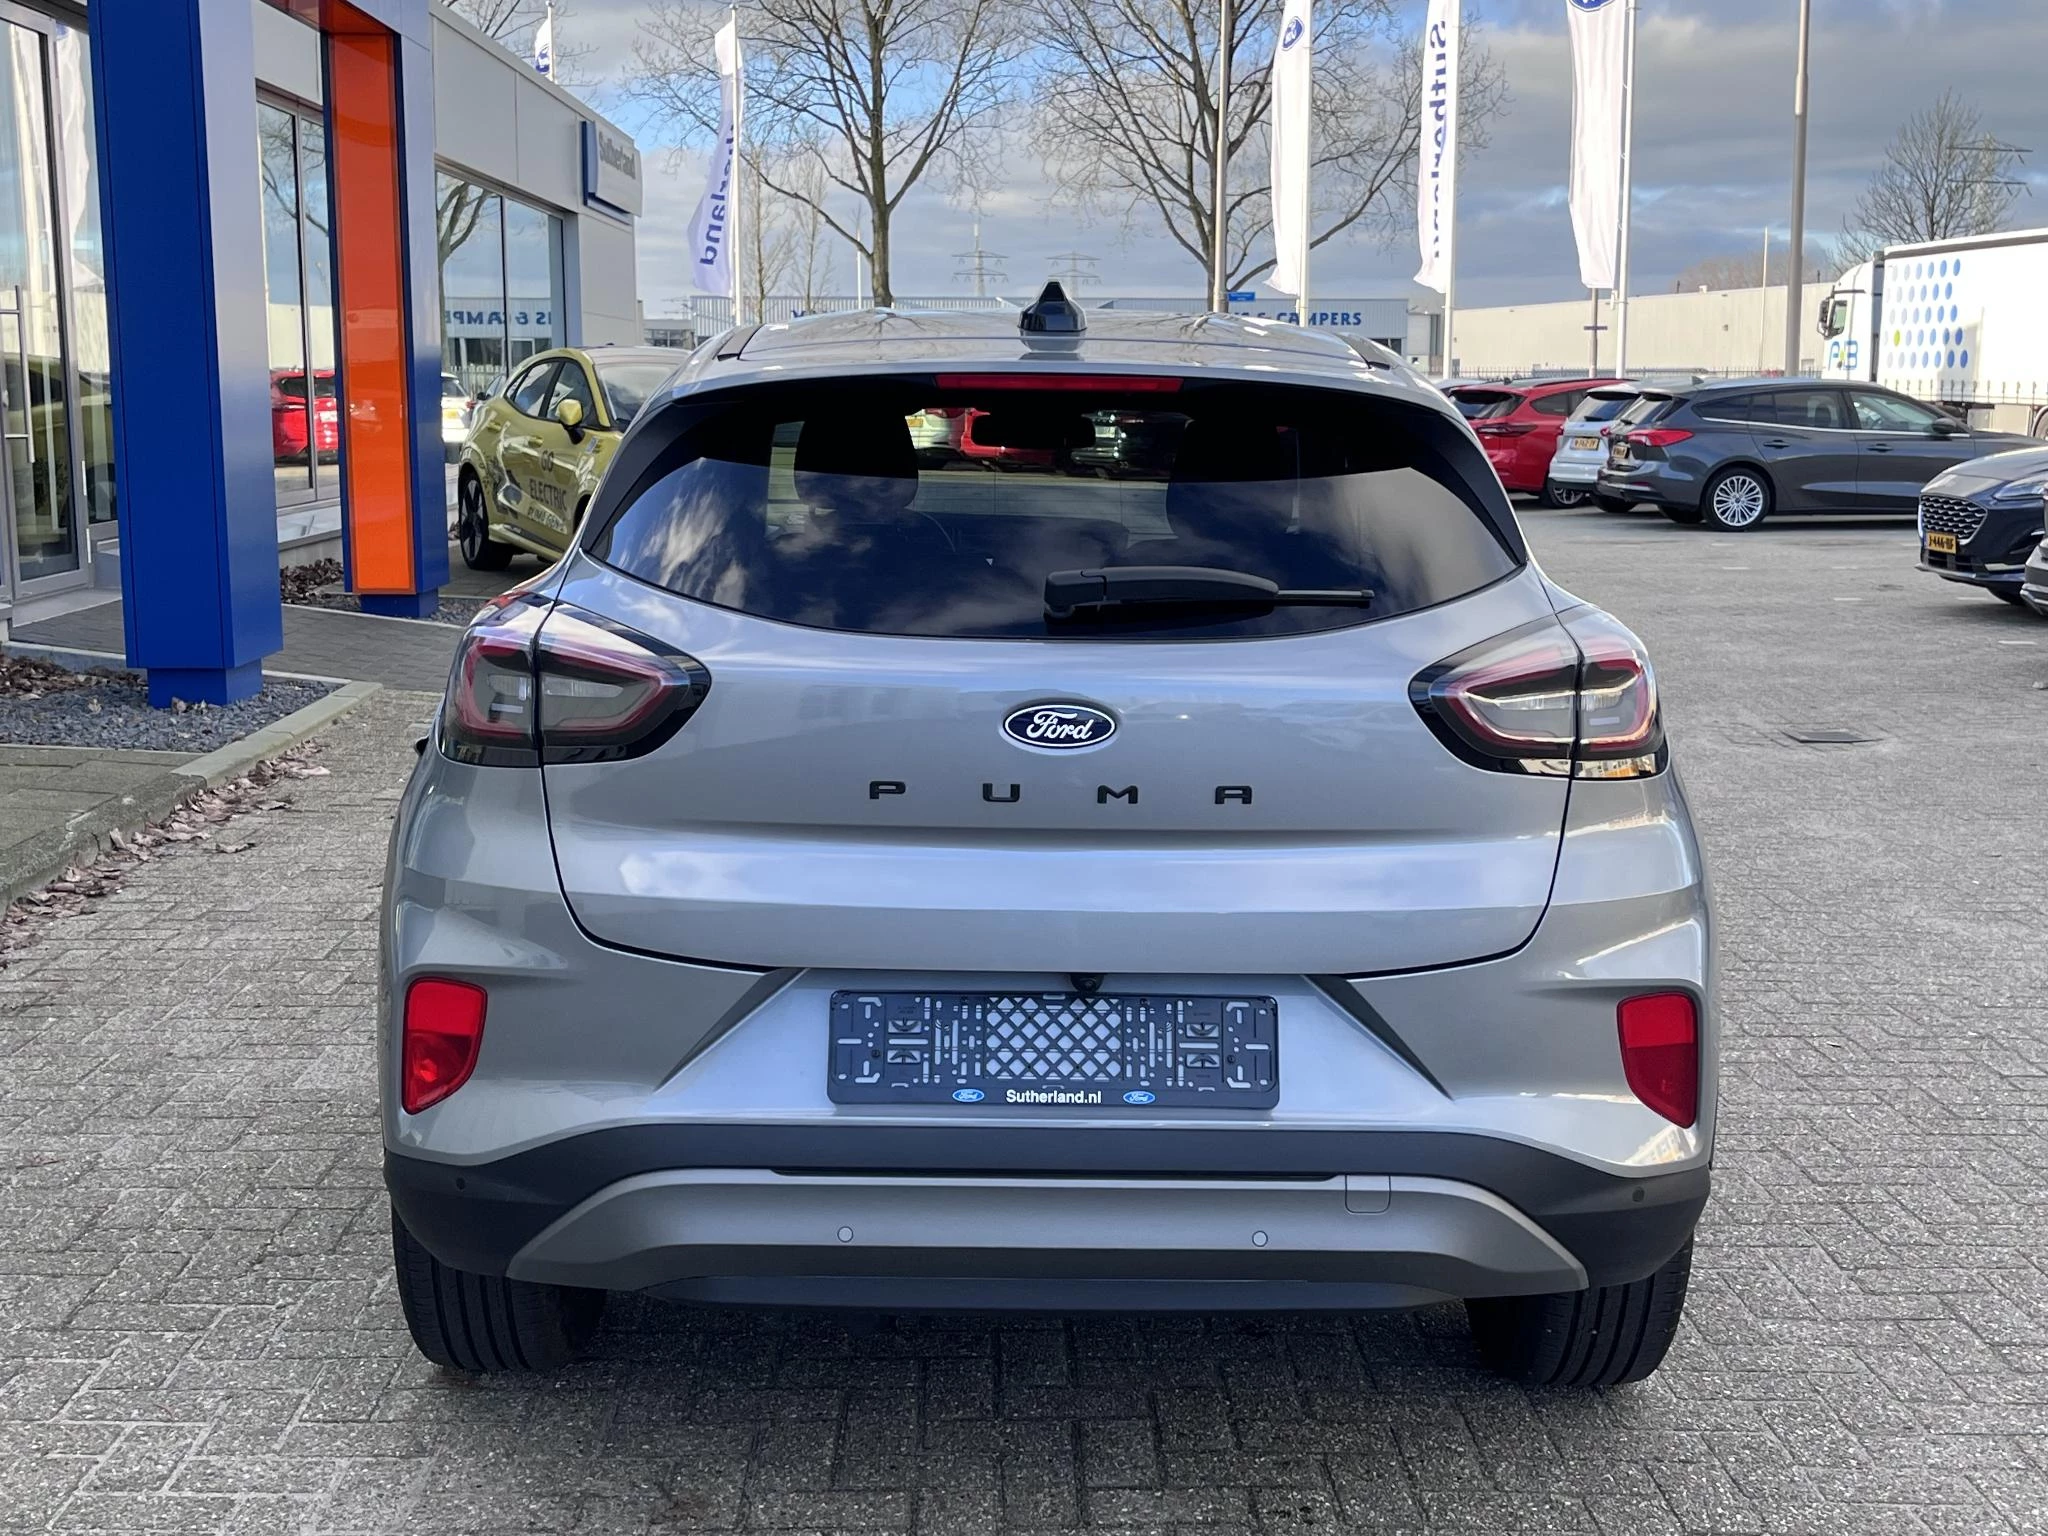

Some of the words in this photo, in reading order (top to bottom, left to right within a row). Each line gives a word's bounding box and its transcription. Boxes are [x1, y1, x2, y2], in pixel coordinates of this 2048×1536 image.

[529, 478, 568, 513] ELECTRIC
[1026, 710, 1094, 740] Ford
[869, 780, 1252, 805] PUMA
[1006, 1089, 1102, 1104] Sutherland.nl
